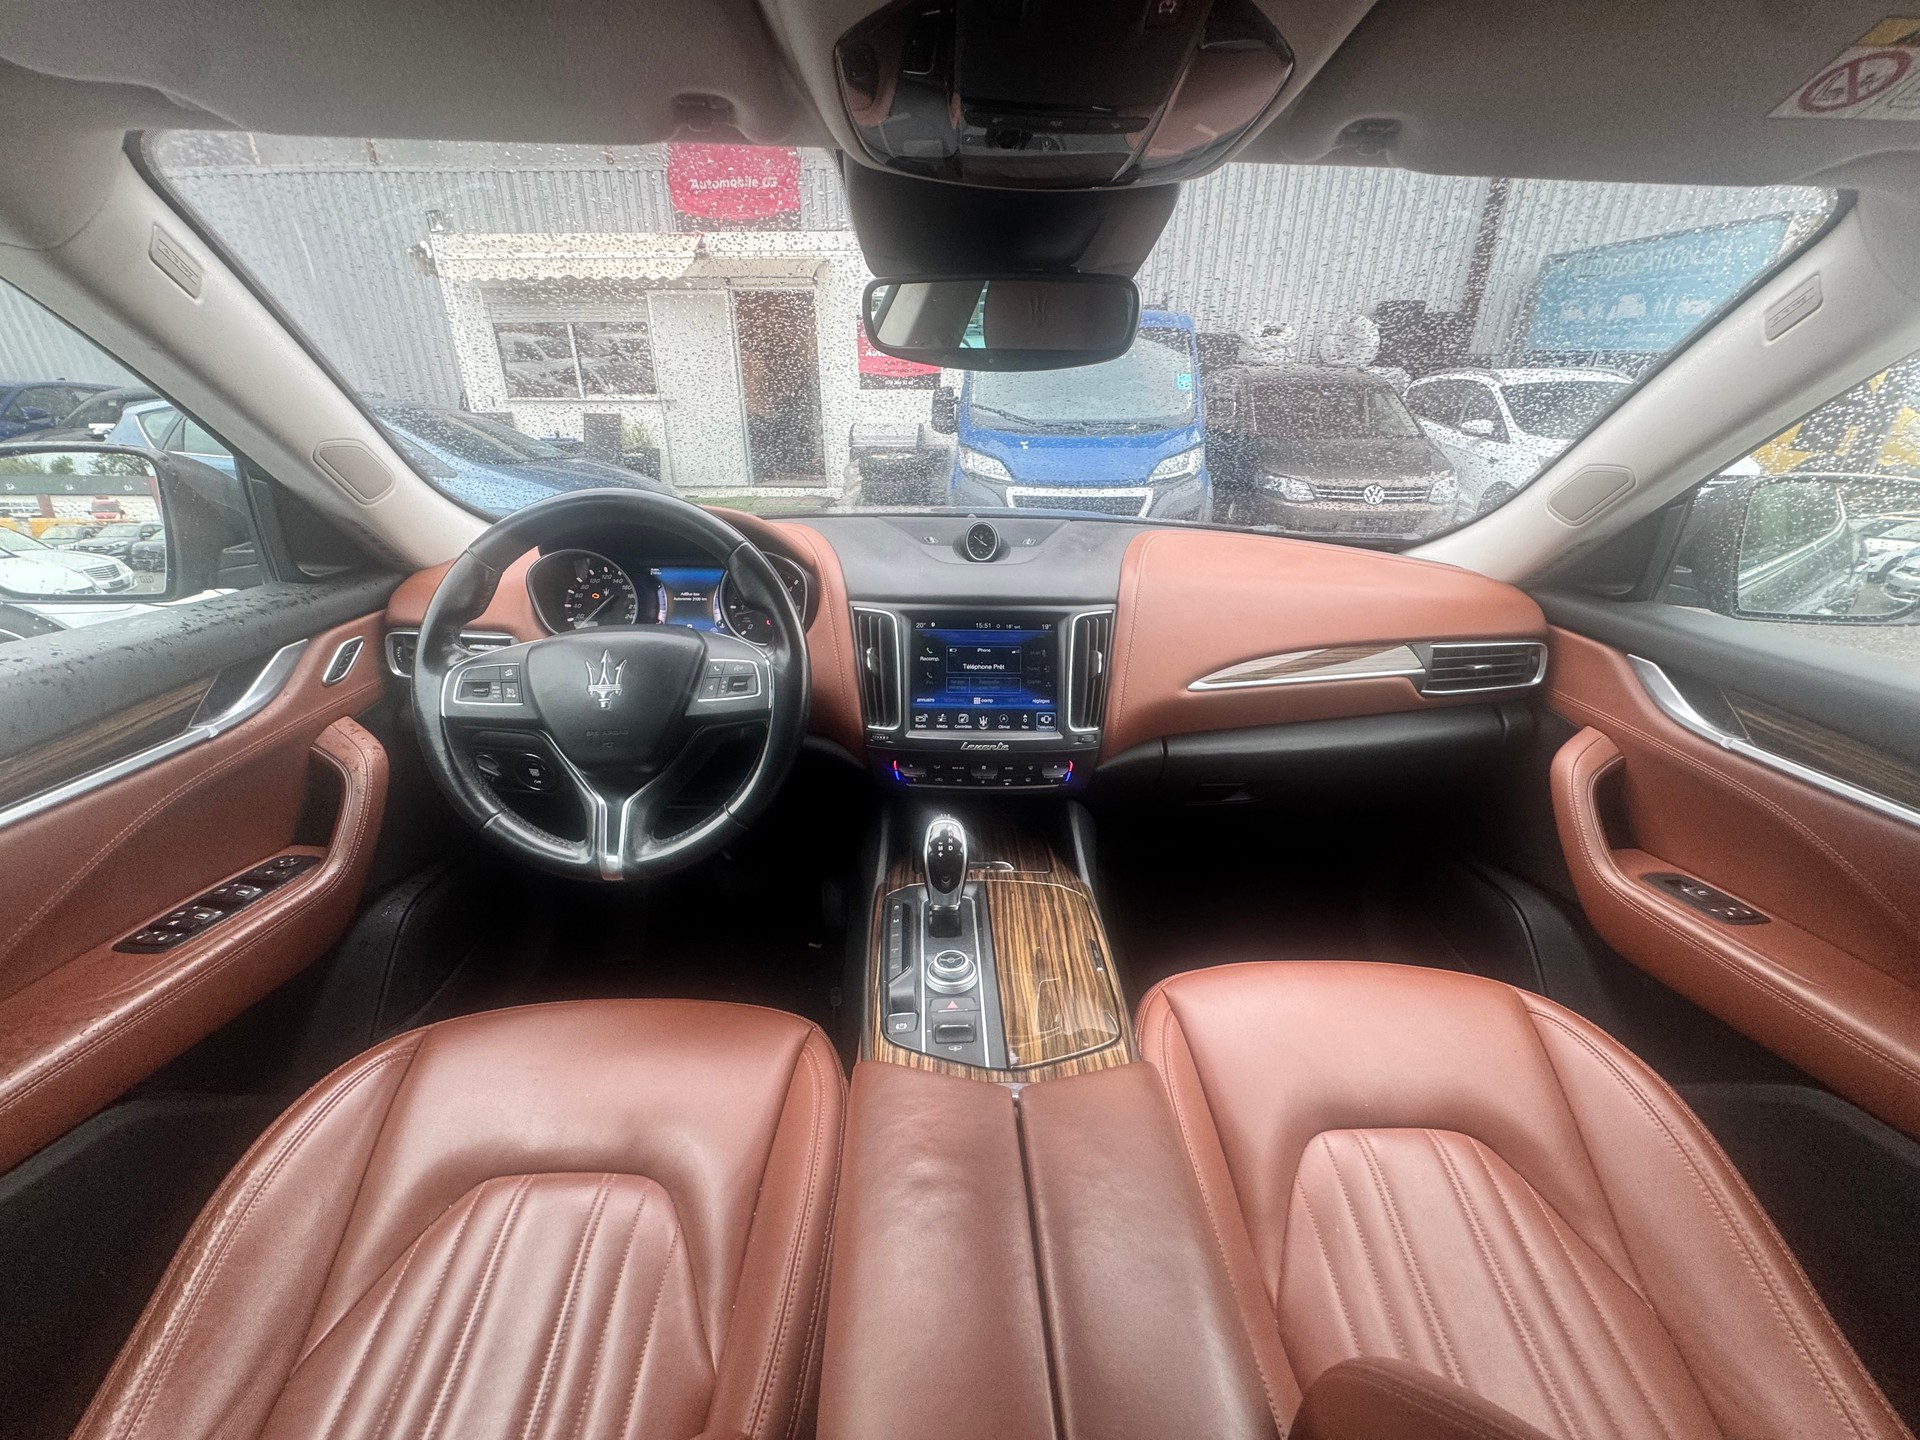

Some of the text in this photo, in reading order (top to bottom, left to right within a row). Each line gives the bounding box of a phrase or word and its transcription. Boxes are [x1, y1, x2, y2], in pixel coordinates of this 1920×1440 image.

[690, 175, 759, 190] Automobile
[963, 663, 992, 671] Téléphone
[960, 741, 1009, 750] Levante
